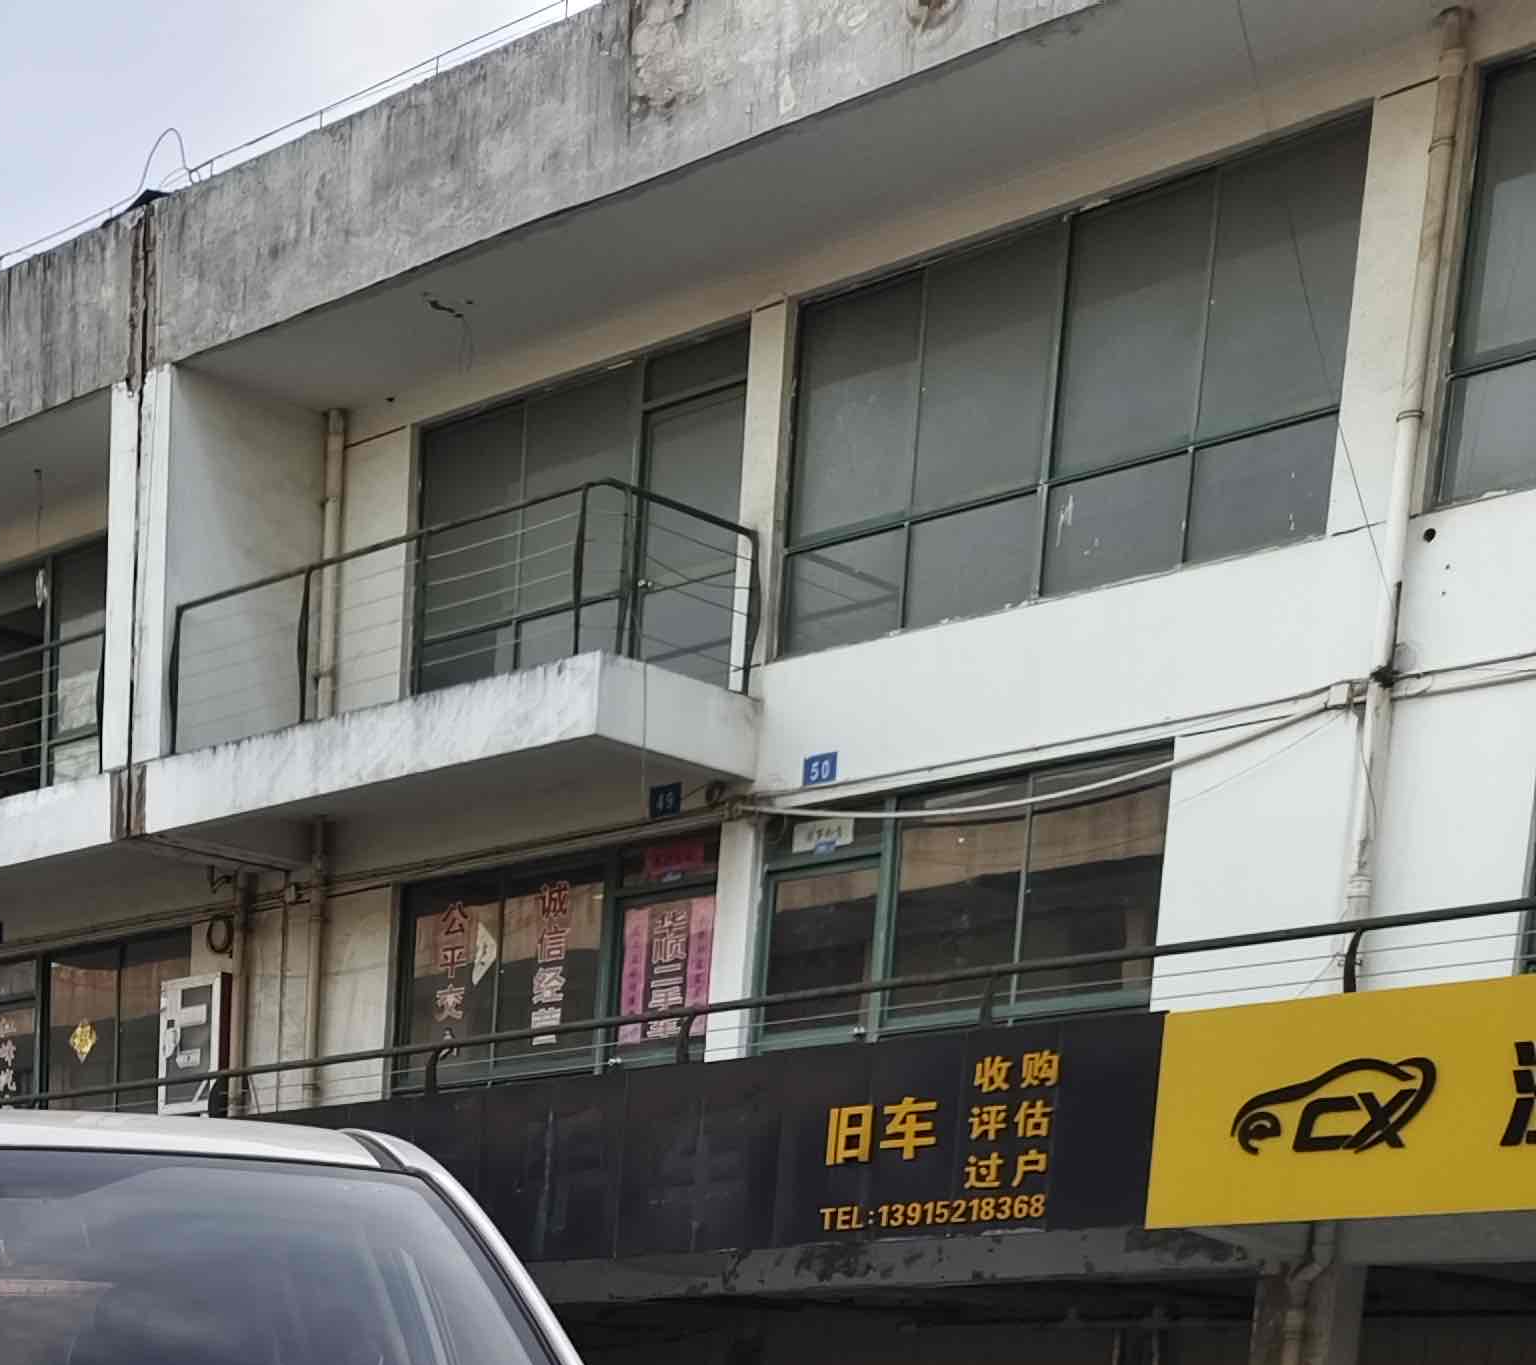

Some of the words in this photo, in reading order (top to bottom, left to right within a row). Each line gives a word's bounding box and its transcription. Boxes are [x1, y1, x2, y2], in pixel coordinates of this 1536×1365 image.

[810, 761, 830, 782] 50
[528, 882, 569, 1046] 诚信经营
[974, 1050, 1060, 1093] 收购
[825, 1097, 938, 1166] 旧车
[968, 1100, 1052, 1140] 评估
[964, 1149, 1047, 1189] 过户
